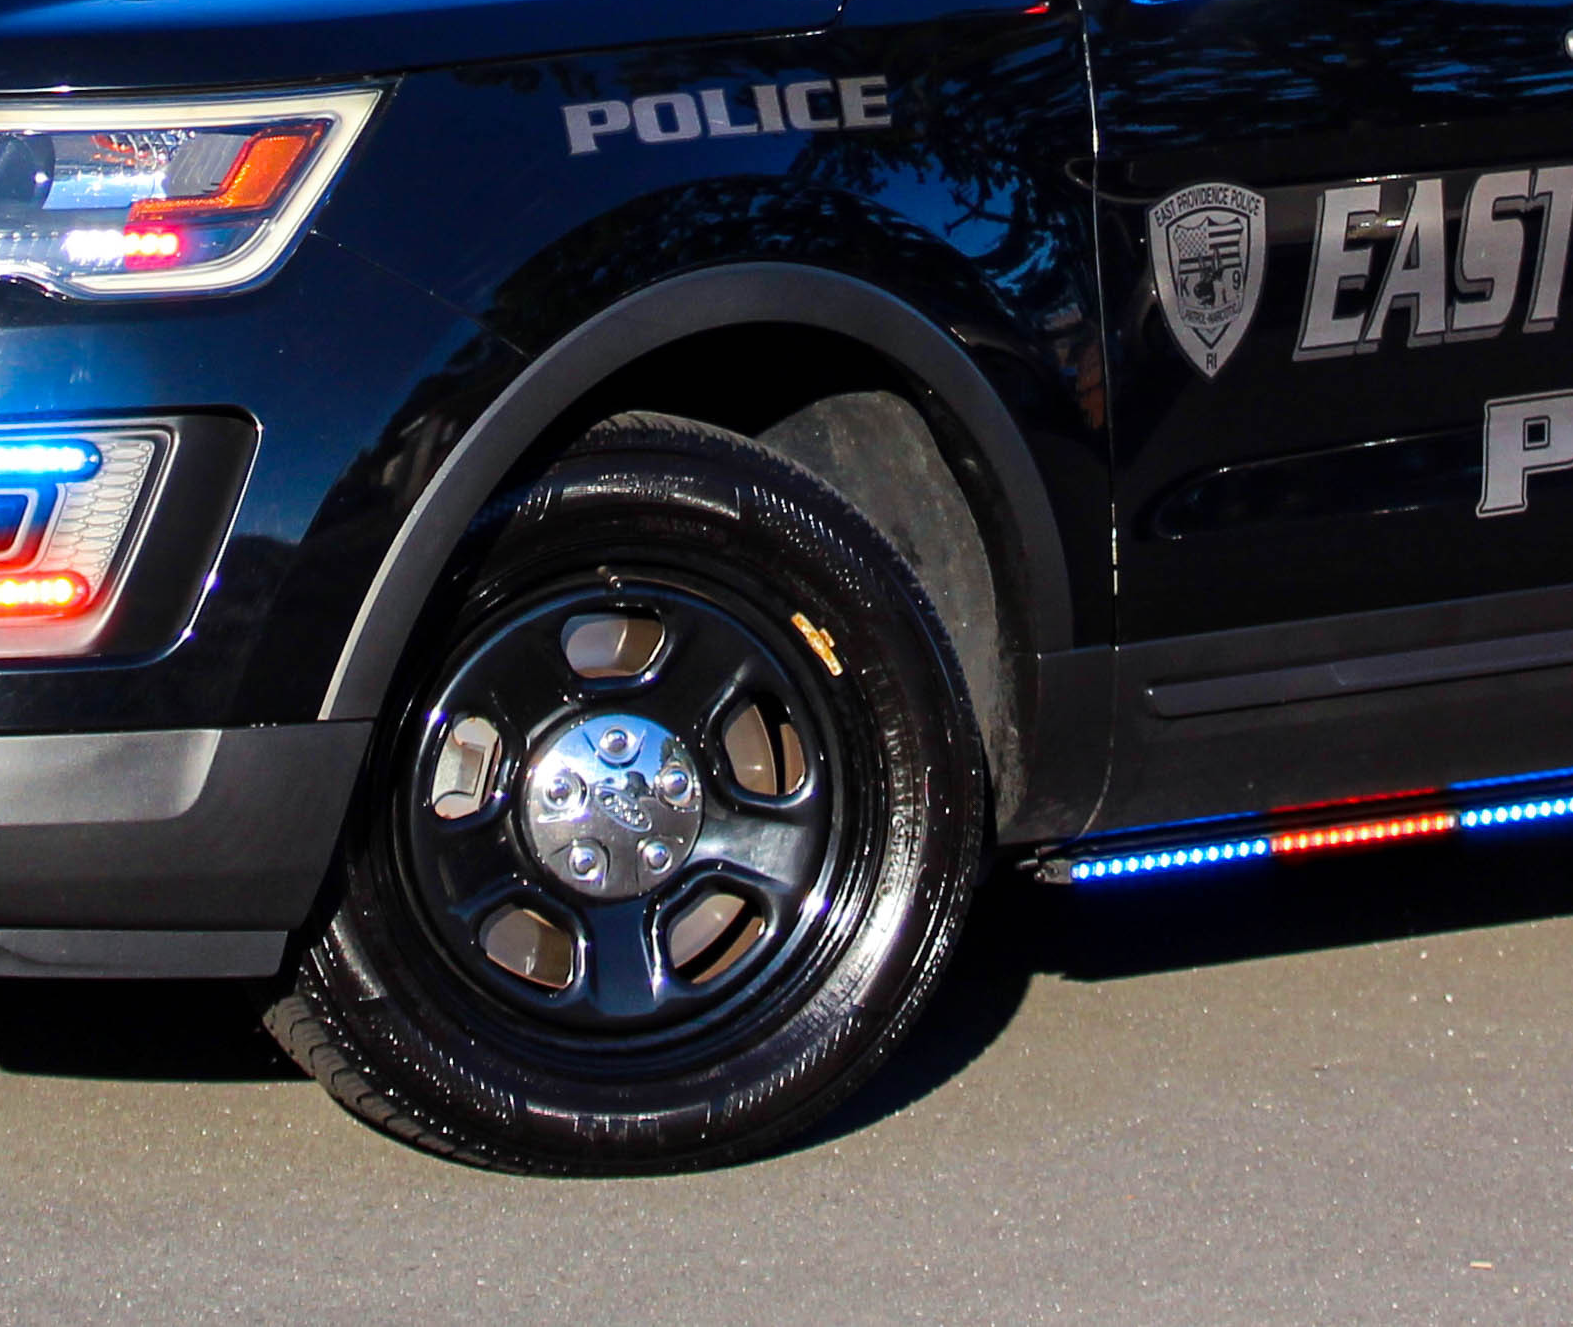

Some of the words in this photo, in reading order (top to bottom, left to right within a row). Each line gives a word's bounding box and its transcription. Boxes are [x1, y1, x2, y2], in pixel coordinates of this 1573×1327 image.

[562, 75, 891, 155] POLICE
[1154, 199, 1177, 227] EAST
[1176, 186, 1229, 212] PROVIDENCE
[1230, 189, 1261, 216] POLICE
[1180, 276, 1190, 297] K
[1232, 270, 1241, 291] 9
[1206, 353, 1218, 370] RI
